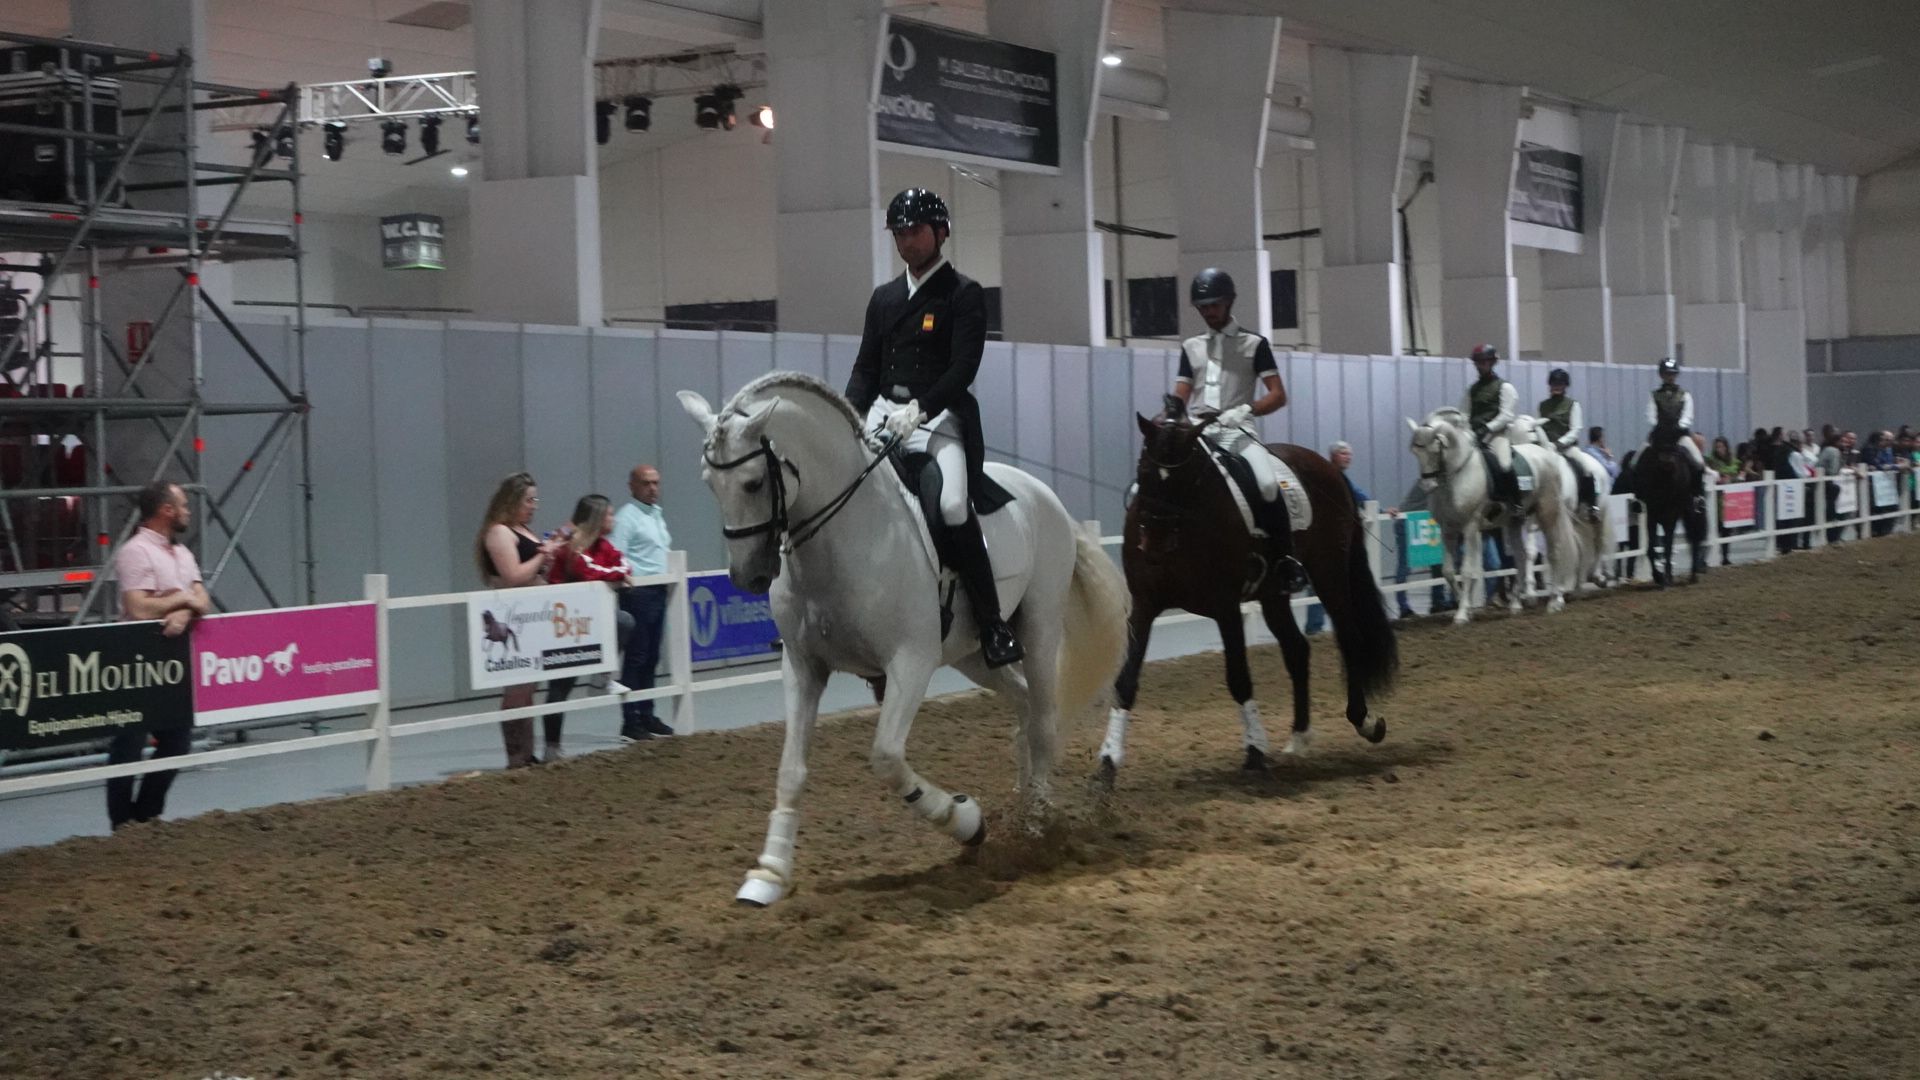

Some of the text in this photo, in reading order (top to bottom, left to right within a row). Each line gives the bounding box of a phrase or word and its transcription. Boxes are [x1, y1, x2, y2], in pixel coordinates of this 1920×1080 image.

[200, 651, 264, 687] Pavo
[485, 655, 531, 673] Caballos
[35, 671, 63, 698] EL
[28, 716, 107, 737] Equipamiento
